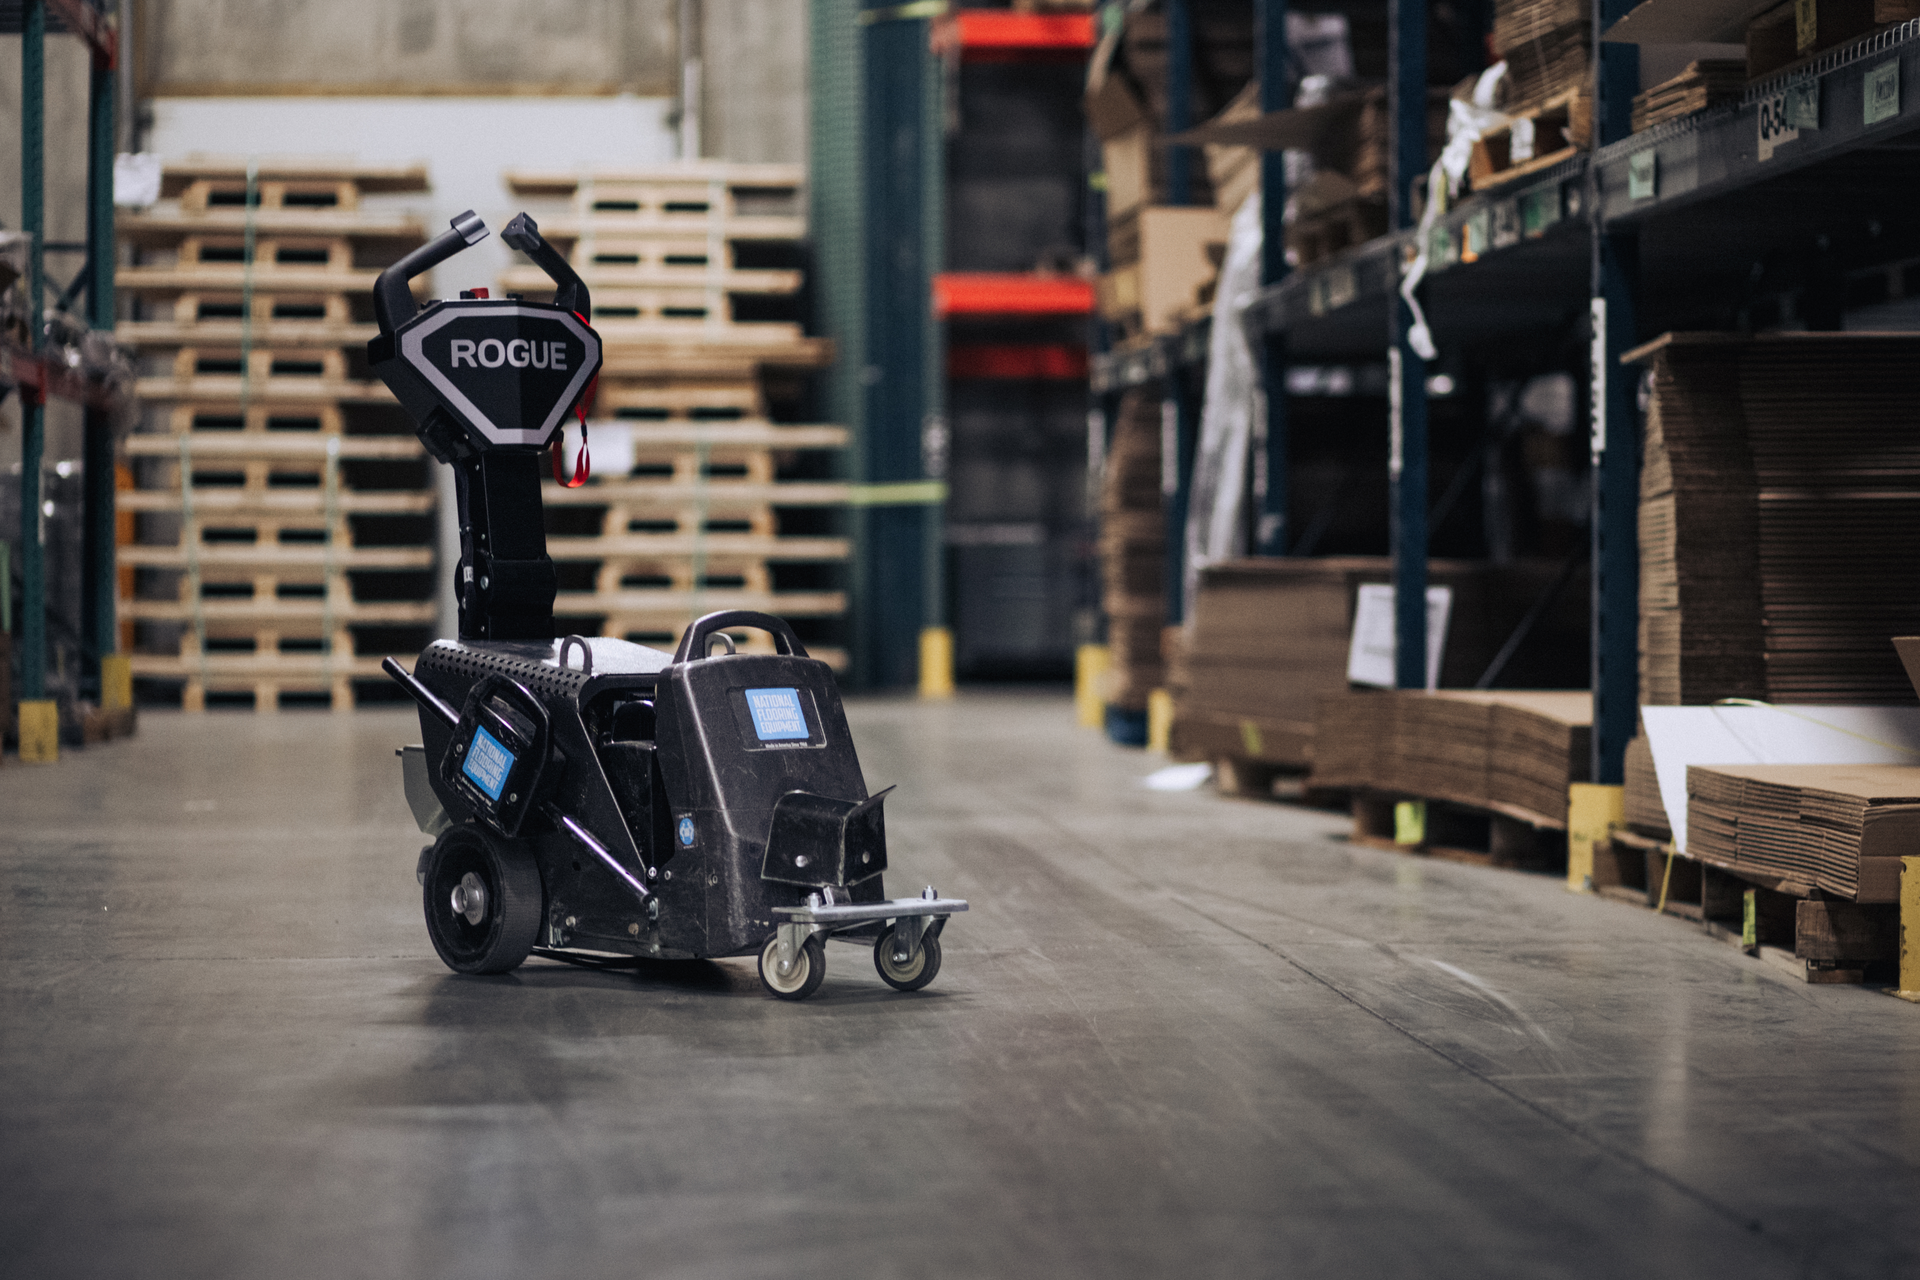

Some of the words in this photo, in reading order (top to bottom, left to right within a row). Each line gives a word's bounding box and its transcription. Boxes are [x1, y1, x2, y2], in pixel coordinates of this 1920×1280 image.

[450, 338, 568, 371] ROGUE
[752, 694, 795, 708] NATIONAL
[756, 707, 799, 721] FLOORING
[760, 720, 802, 734] EQUIPMENT
[471, 745, 504, 781] FLOORING
[476, 733, 507, 770] NATIONAL
[467, 757, 499, 792] EQUIPMENT
